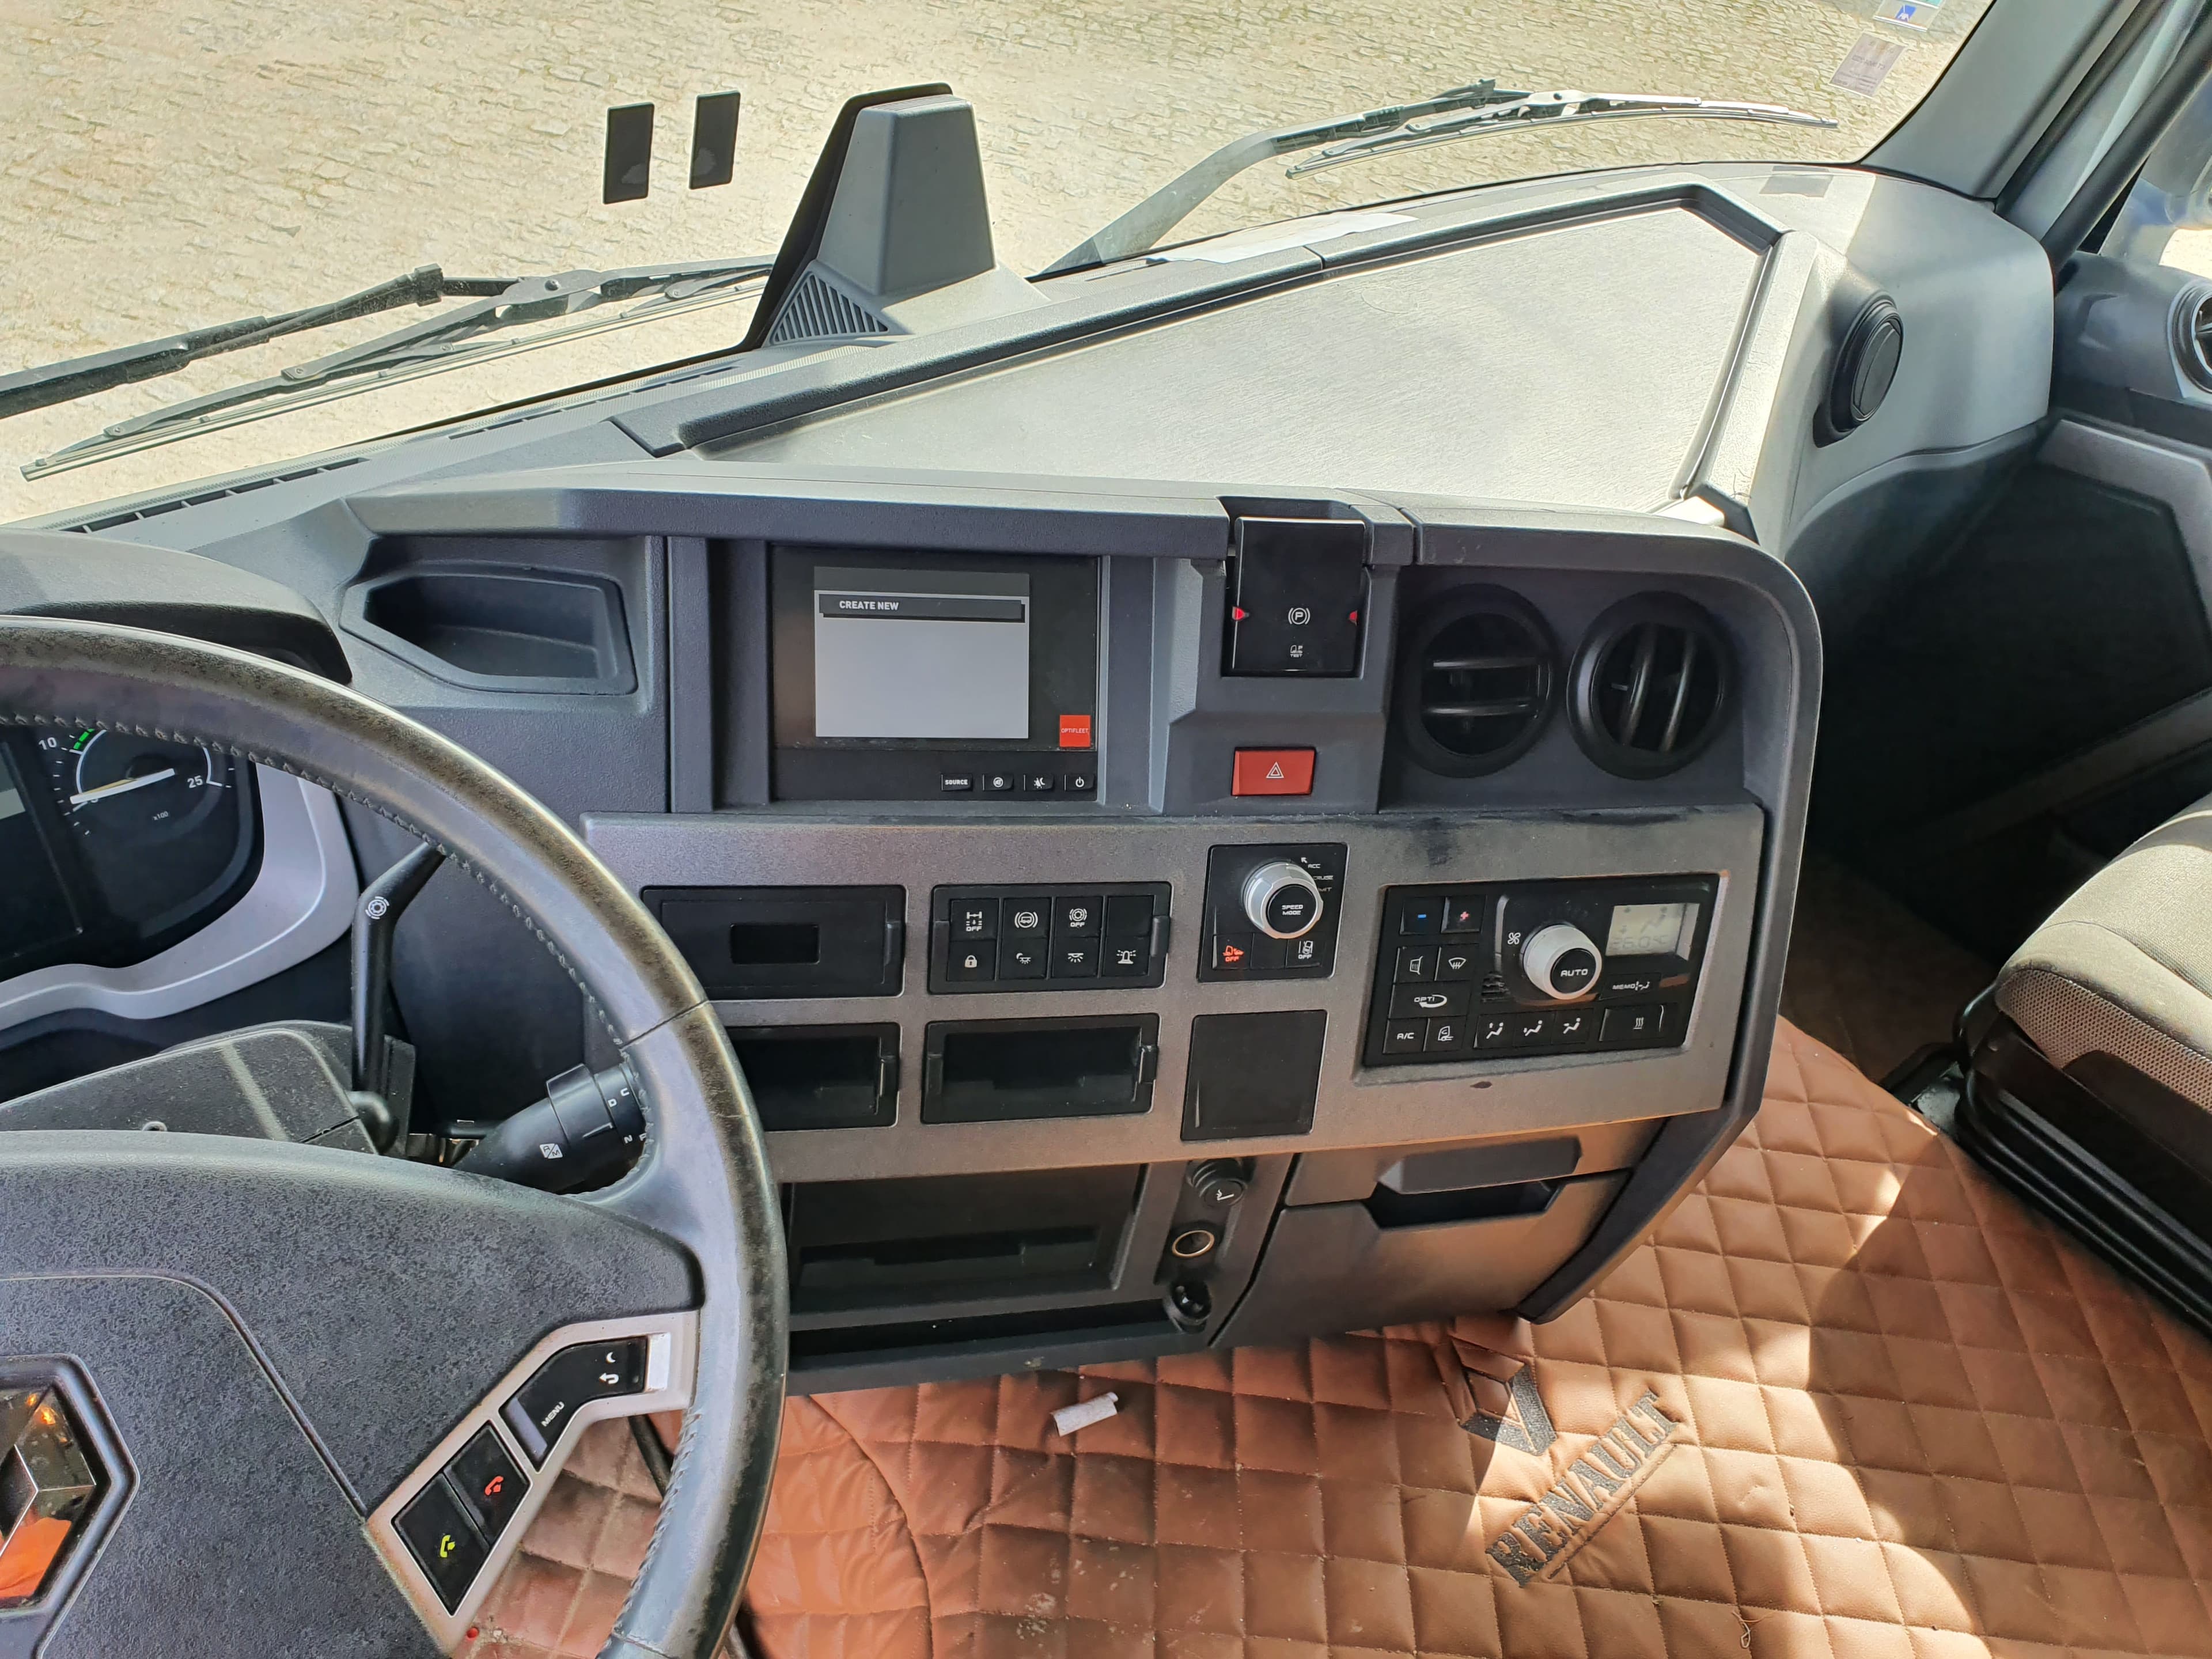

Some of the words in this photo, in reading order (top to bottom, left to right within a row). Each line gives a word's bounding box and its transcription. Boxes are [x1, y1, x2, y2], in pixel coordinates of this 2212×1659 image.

[839, 601, 876, 609] CREATE
[877, 602, 899, 610] NEW
[1294, 612, 1304, 620] P
[39, 737, 57, 750] 10
[187, 775, 203, 788] 25
[153, 811, 169, 820] x100
[1560, 968, 1588, 977] AUTO
[608, 1099, 617, 1107] D
[624, 1135, 633, 1143] N
[541, 1402, 565, 1427] MENU
[1485, 1388, 1679, 1588] RENAULT
